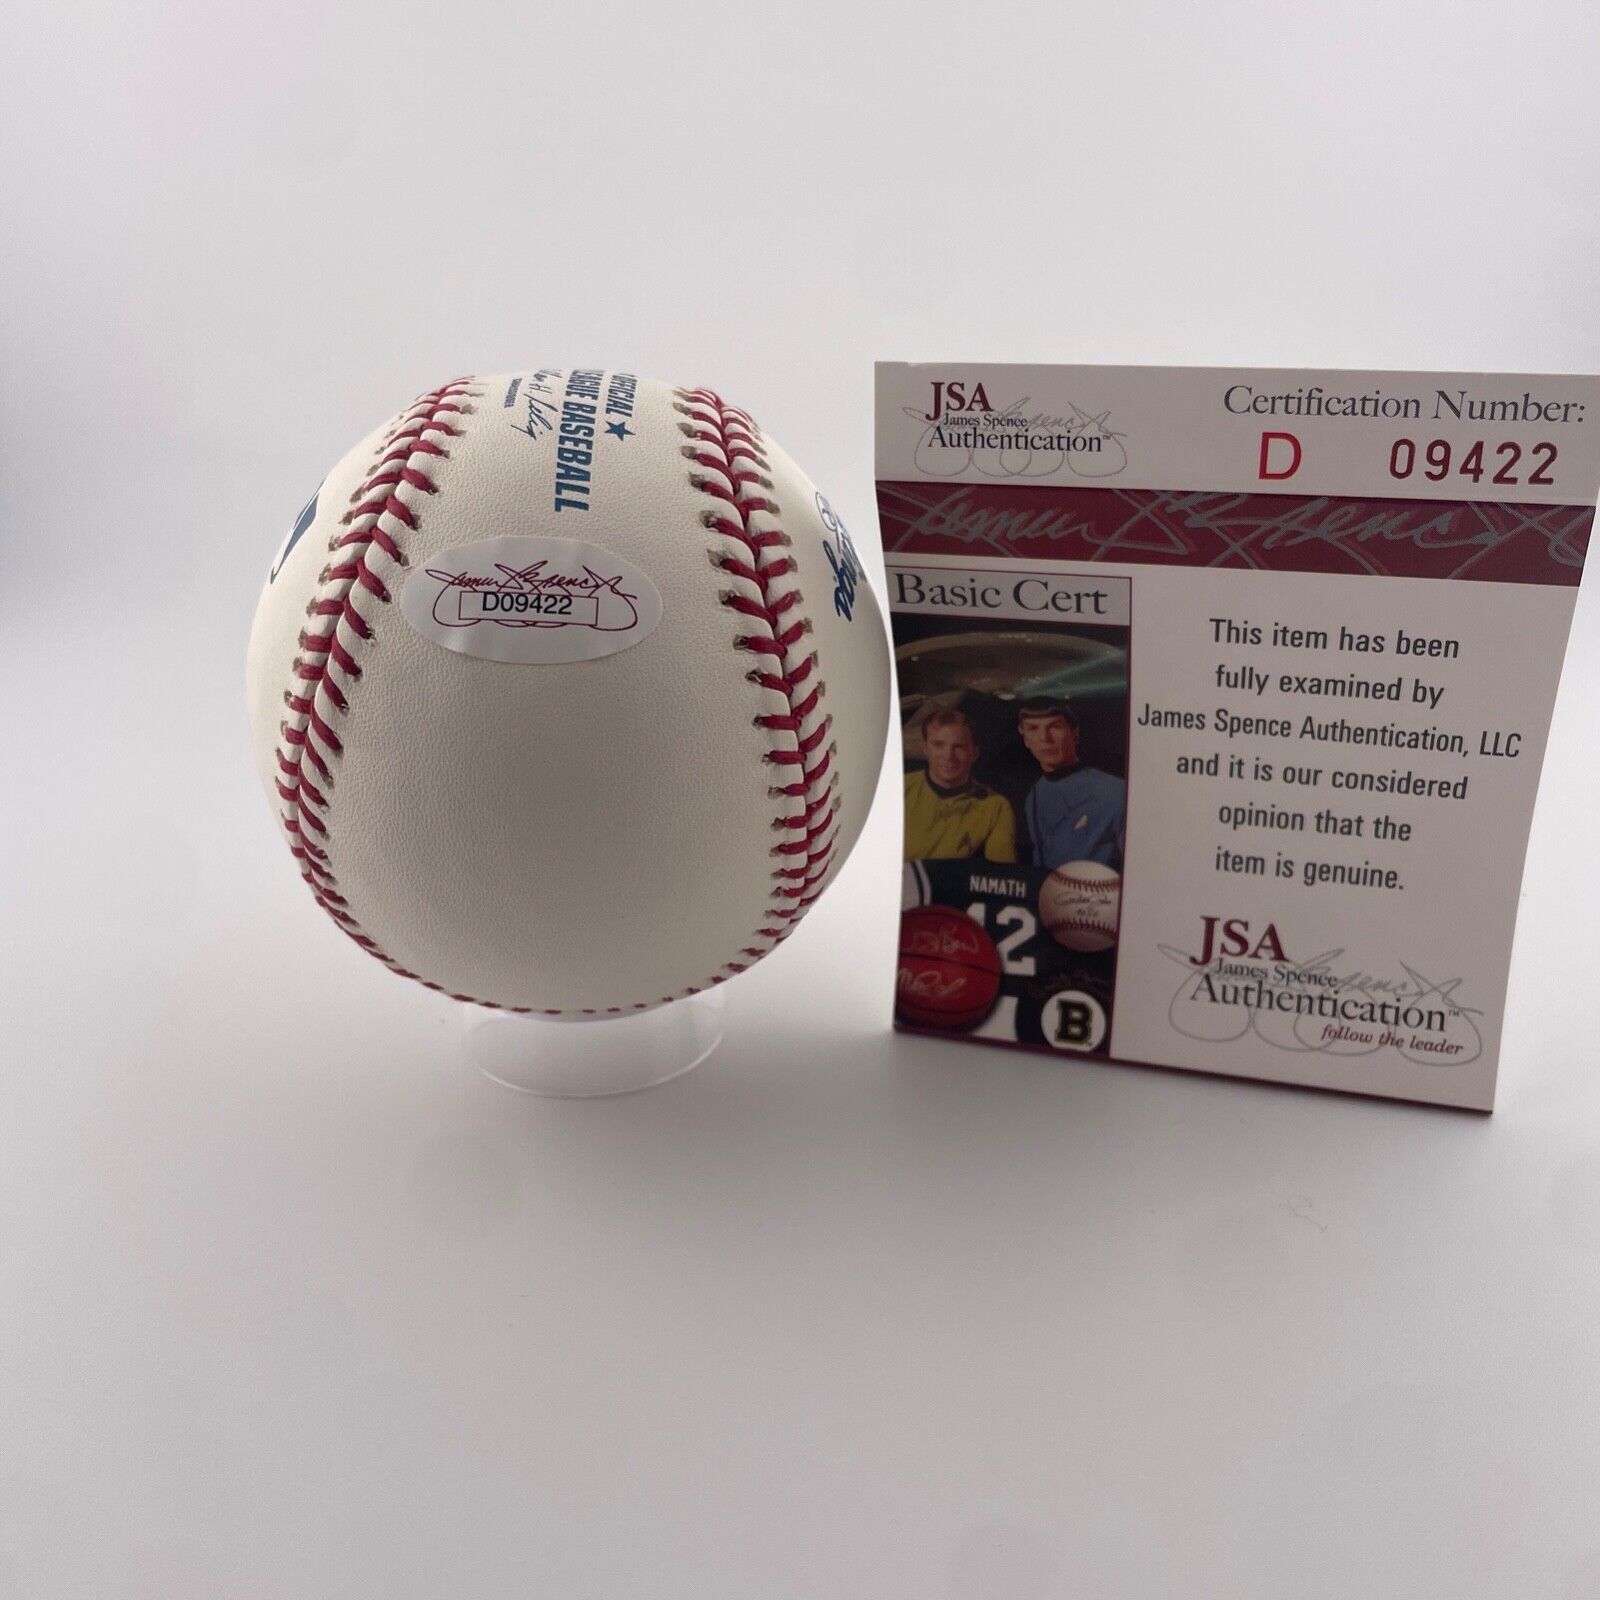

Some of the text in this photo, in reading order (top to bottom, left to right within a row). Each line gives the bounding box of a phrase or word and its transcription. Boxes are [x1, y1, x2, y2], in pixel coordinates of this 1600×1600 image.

[925, 381, 994, 421] JSA
[943, 413, 980, 427] James
[983, 414, 1028, 430] Spence
[1223, 385, 1585, 423] Certification Number:
[555, 401, 597, 512] BASEBALL
[1258, 431, 1558, 485] D 09422
[482, 591, 573, 615] D09422
[895, 573, 1108, 614] Basic Cert
[1209, 618, 1459, 659] This item has been
[1215, 665, 1444, 709] fully examined by
[1137, 703, 1522, 758] James Spence Authentication, LLC
[1176, 753, 1468, 800] and it is our considered
[1218, 805, 1412, 842] opinion that the
[969, 875, 1026, 897] NAMATH
[1215, 846, 1404, 890] item is genuine.
[1190, 915, 1289, 966] JSA
[1215, 957, 1268, 980] James
[1273, 964, 1338, 988] Spence
[1321, 1023, 1463, 1056] follow the leader
